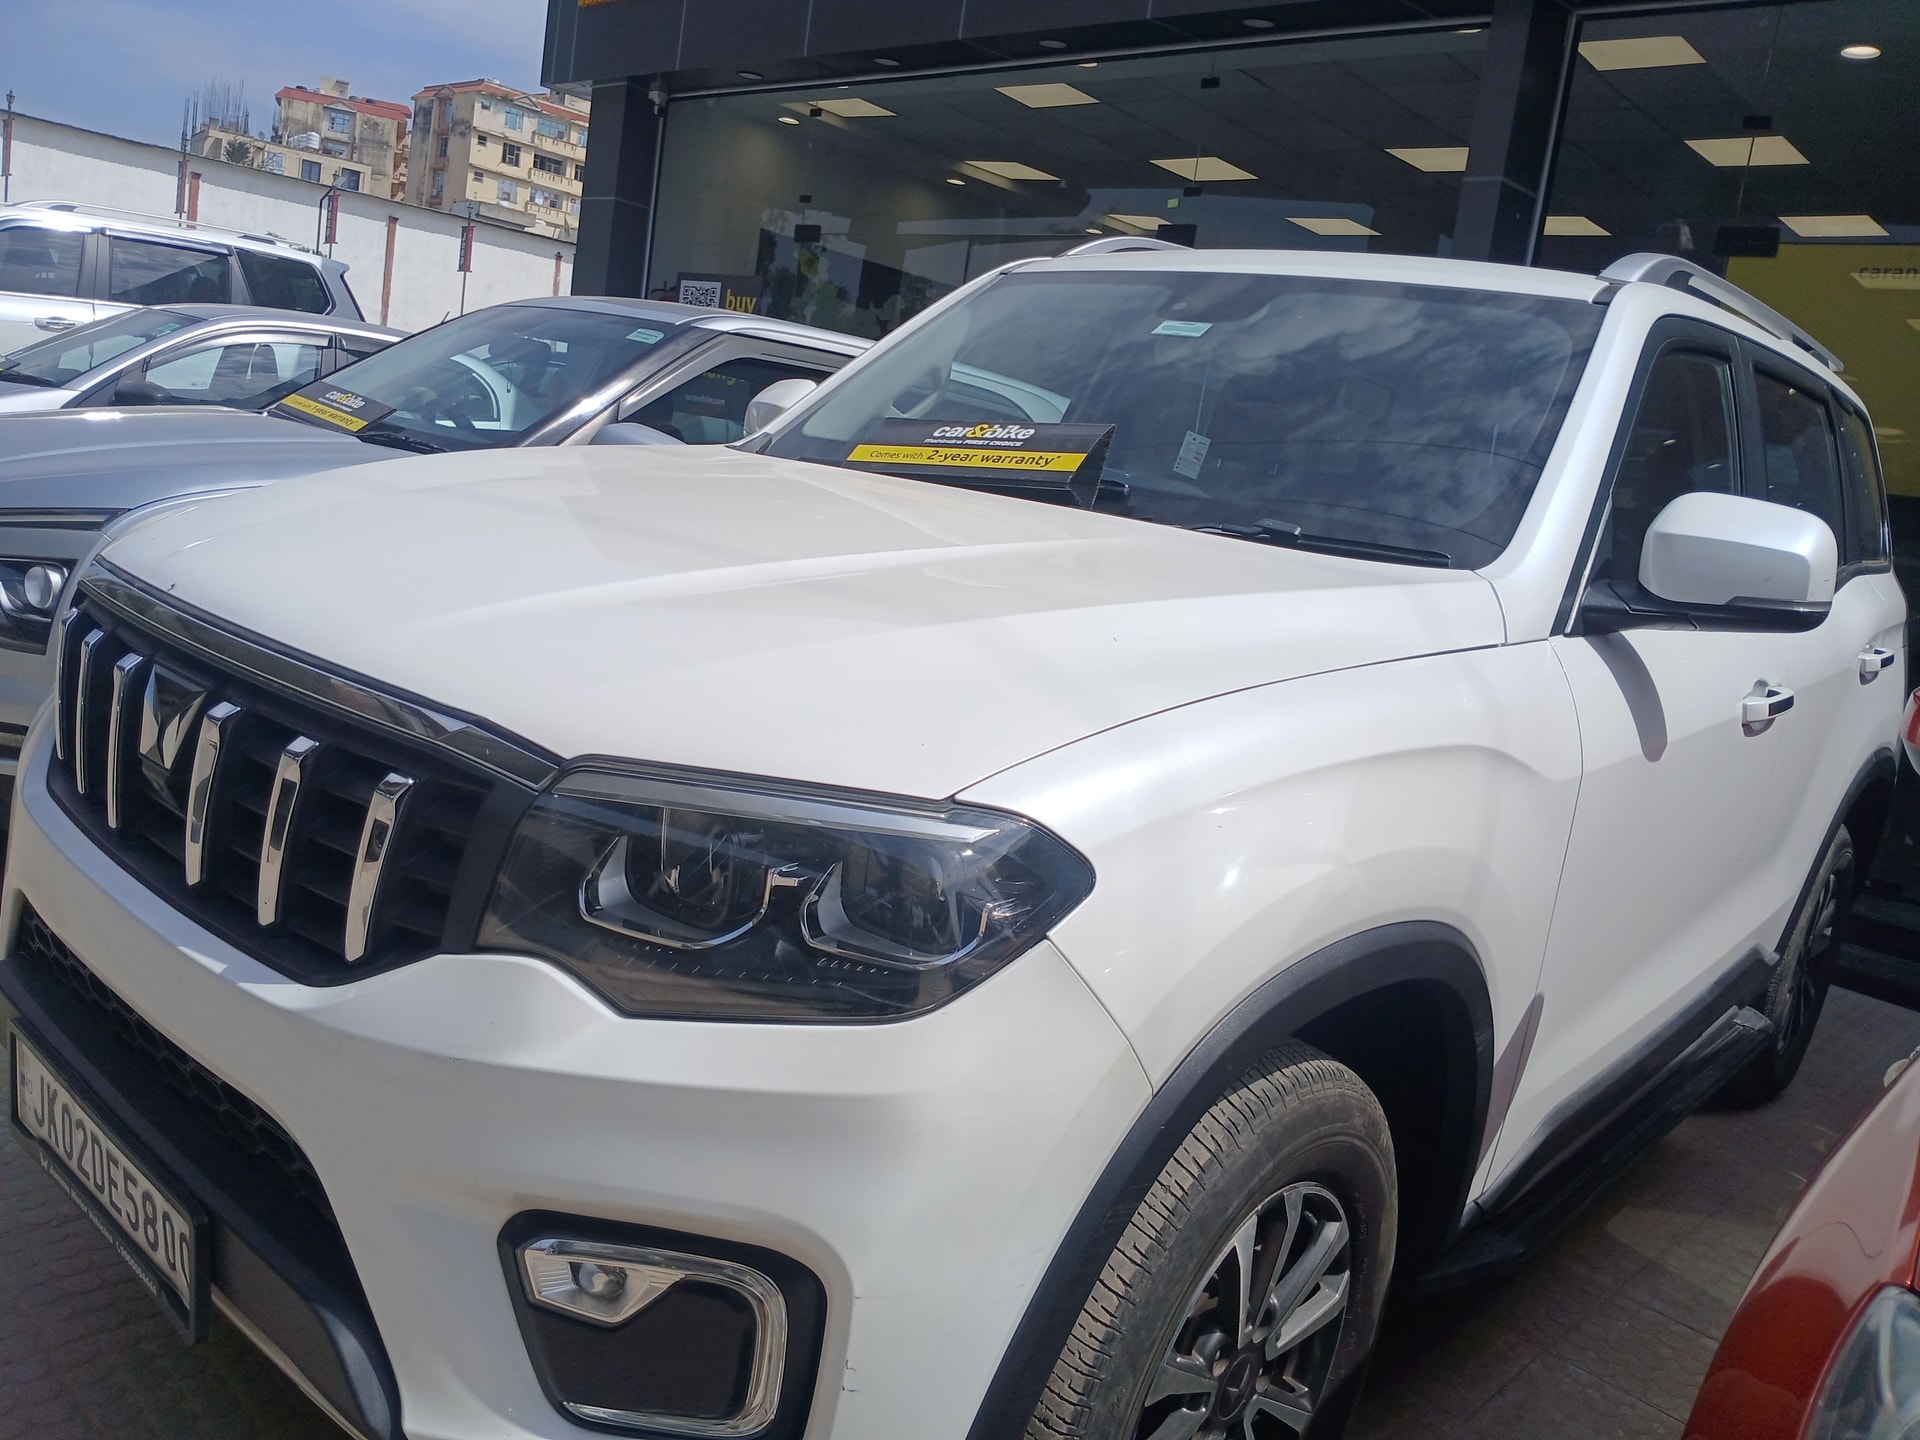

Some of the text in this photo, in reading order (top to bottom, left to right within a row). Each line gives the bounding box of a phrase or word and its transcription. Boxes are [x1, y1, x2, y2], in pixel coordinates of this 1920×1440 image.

[726, 289, 756, 313] buy
[325, 391, 365, 408] car&bike
[933, 424, 1035, 439] car&bike
[869, 449, 901, 460] Comes
[902, 451, 924, 461] with
[926, 450, 979, 464] 2-year
